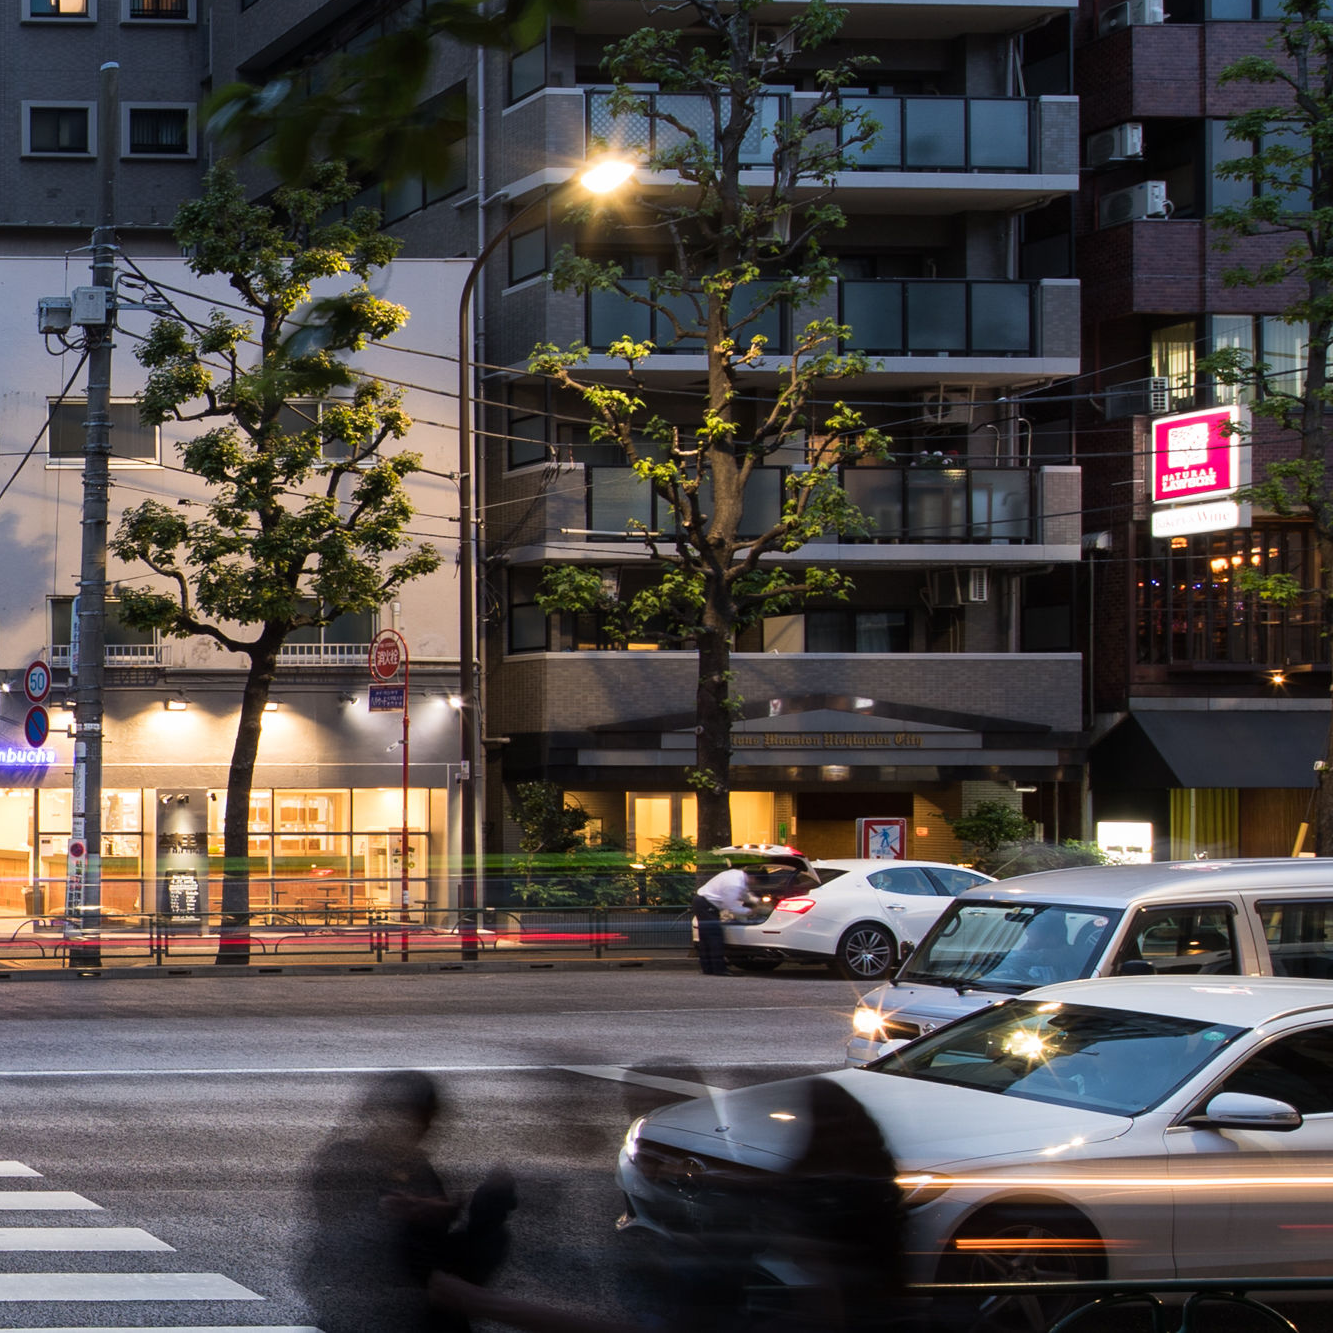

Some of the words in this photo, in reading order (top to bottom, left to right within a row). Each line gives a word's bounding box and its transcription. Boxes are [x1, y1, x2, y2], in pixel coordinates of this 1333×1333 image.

[1162, 467, 1216, 483] NATURAL
[1162, 475, 1216, 492] LAWSON
[377, 650, 399, 666] 消火栓
[30, 672, 45, 691] 50
[730, 733, 759, 746] ions
[763, 733, 820, 748] Mansion
[823, 733, 891, 748] Nishiazabu
[894, 733, 924, 748] City
